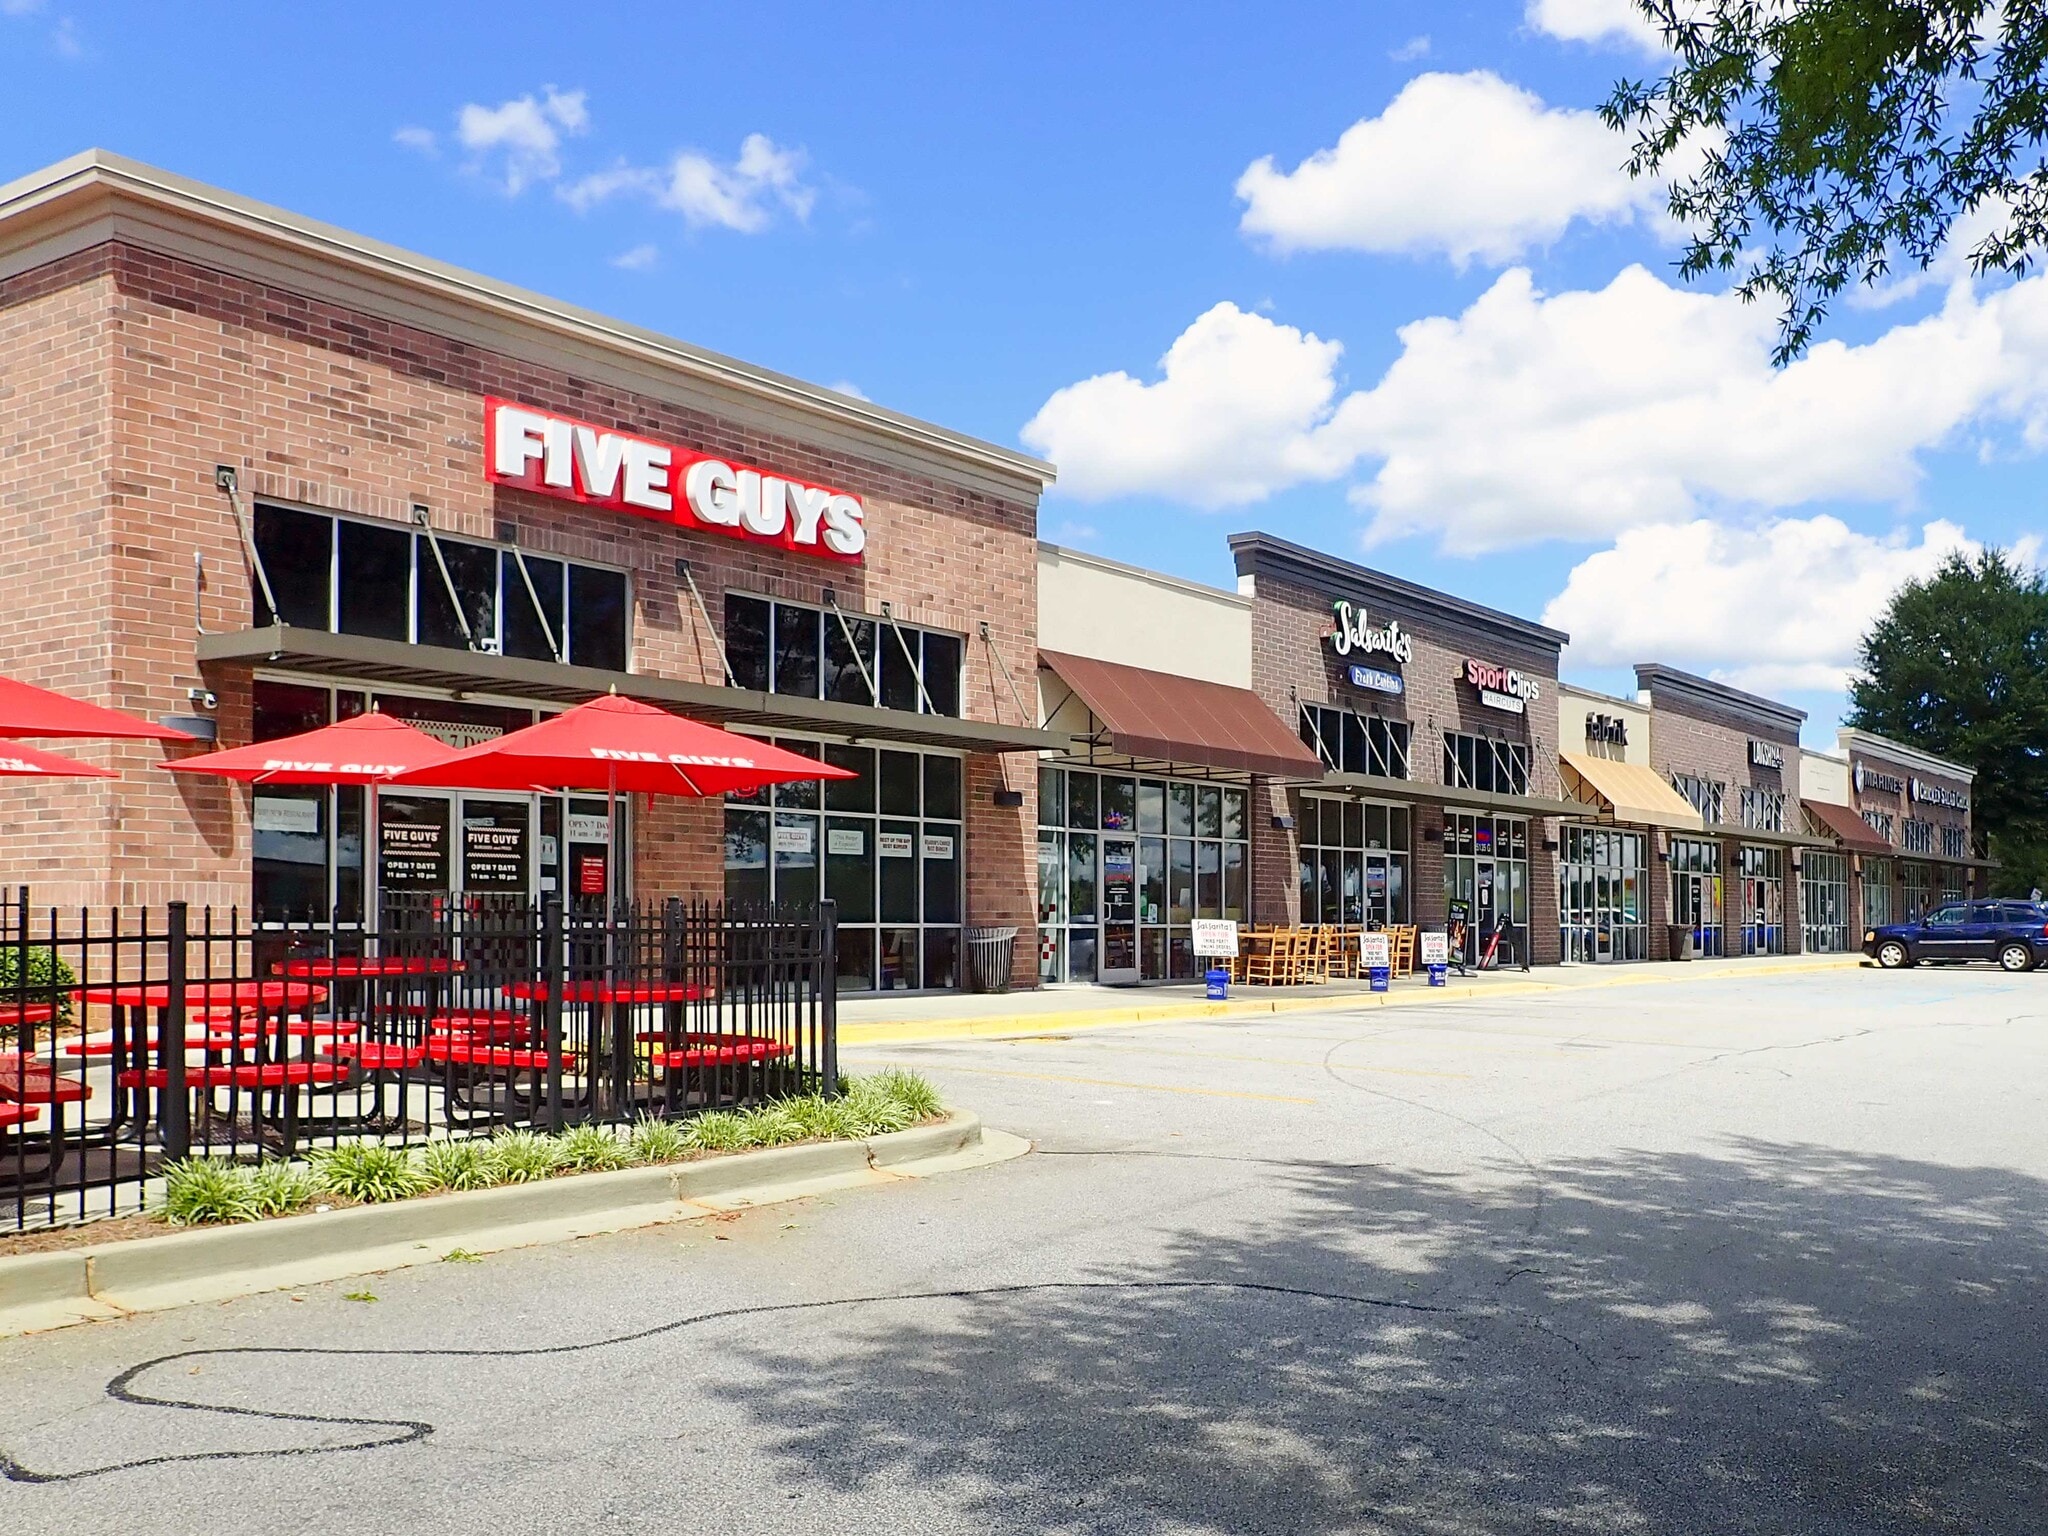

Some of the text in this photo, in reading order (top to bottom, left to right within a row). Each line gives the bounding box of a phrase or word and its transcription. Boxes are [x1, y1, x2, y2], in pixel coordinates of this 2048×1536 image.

[495, 405, 865, 555] FIVE GUYS
[1355, 668, 1373, 685] Fresh
[1483, 692, 1522, 711] HAIRCUTS
[590, 747, 663, 763] FIVE
[263, 759, 407, 775] FIVE GUY
[1864, 770, 1904, 794] MARINES
[568, 820, 588, 828] OPEN
[596, 821, 609, 829] DAY
[383, 829, 438, 842] FIVE GUYS
[468, 833, 518, 845] FIVE GUYS
[387, 861, 409, 869] OPEN
[416, 862, 436, 870] DAYS
[471, 863, 491, 871] OPEN
[498, 864, 517, 872] DAYS
